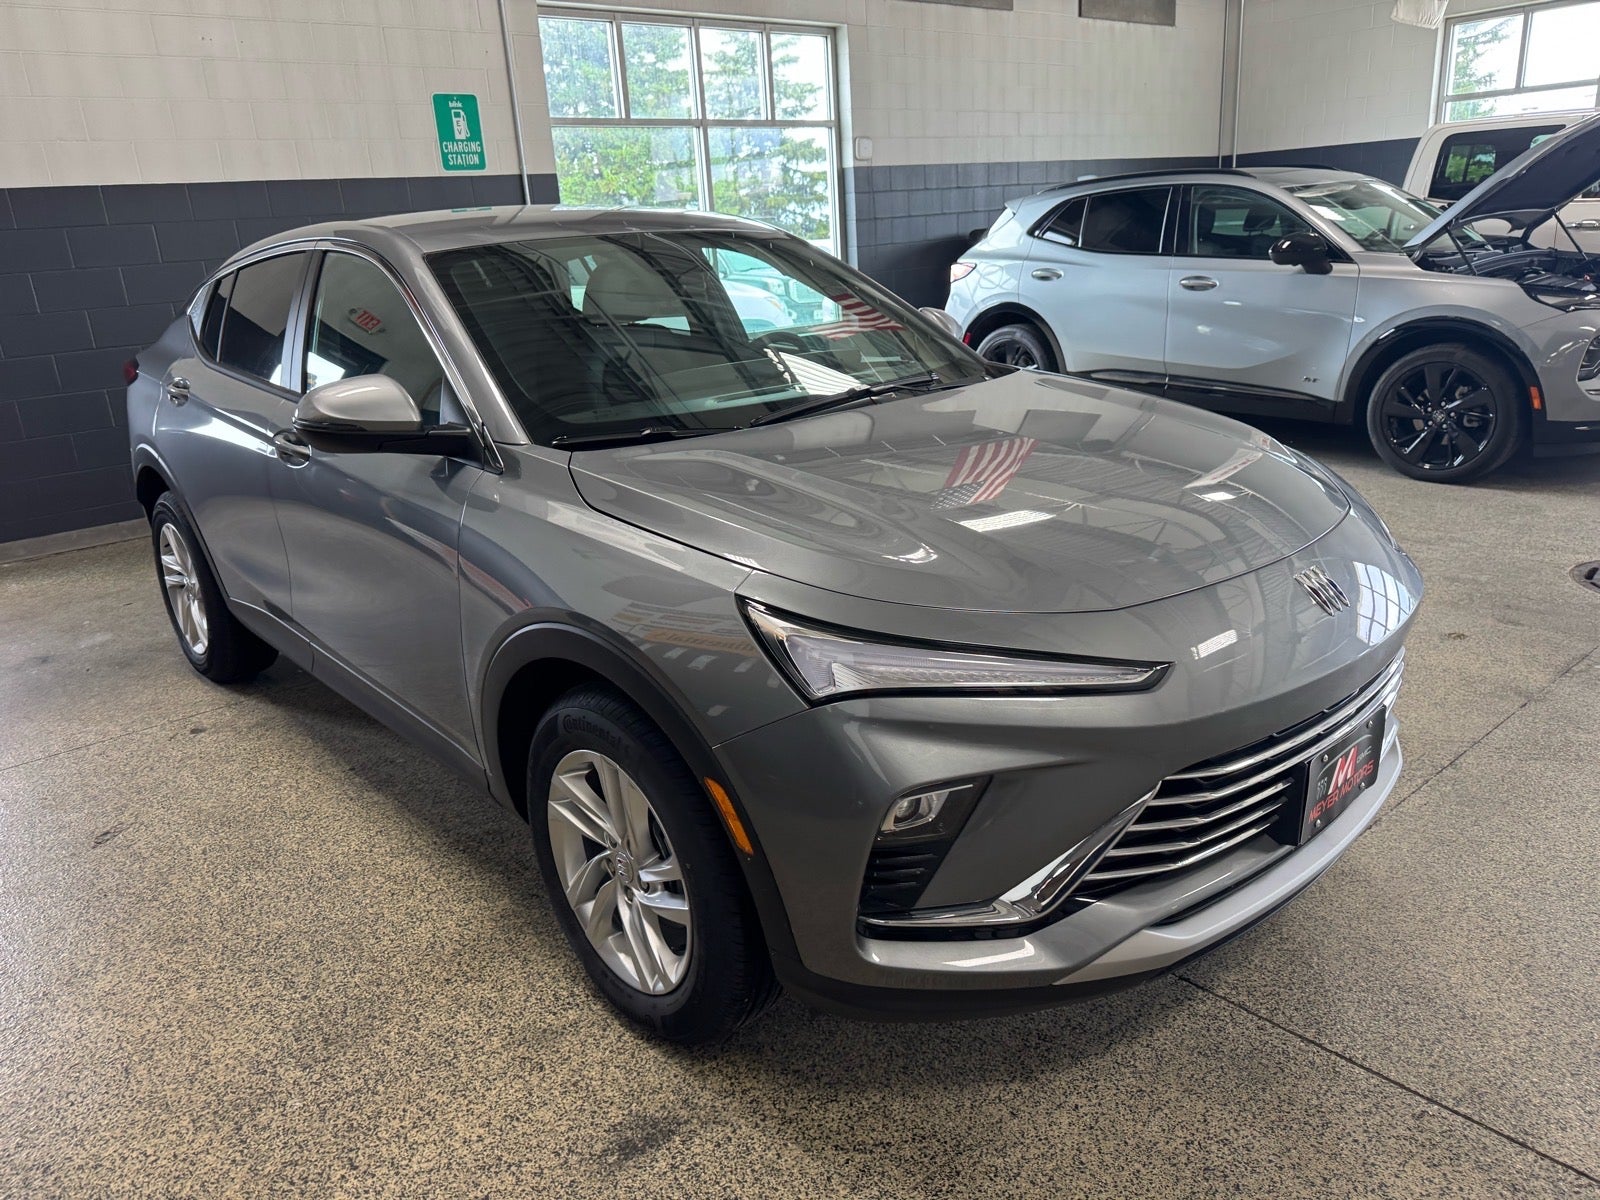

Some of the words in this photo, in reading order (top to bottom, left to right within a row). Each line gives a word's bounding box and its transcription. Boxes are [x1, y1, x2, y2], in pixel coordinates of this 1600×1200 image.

[443, 141, 481, 153] CHARGING
[448, 153, 479, 167] STATION
[1309, 792, 1339, 823] MEYER
[1340, 760, 1374, 797] MOTORS
